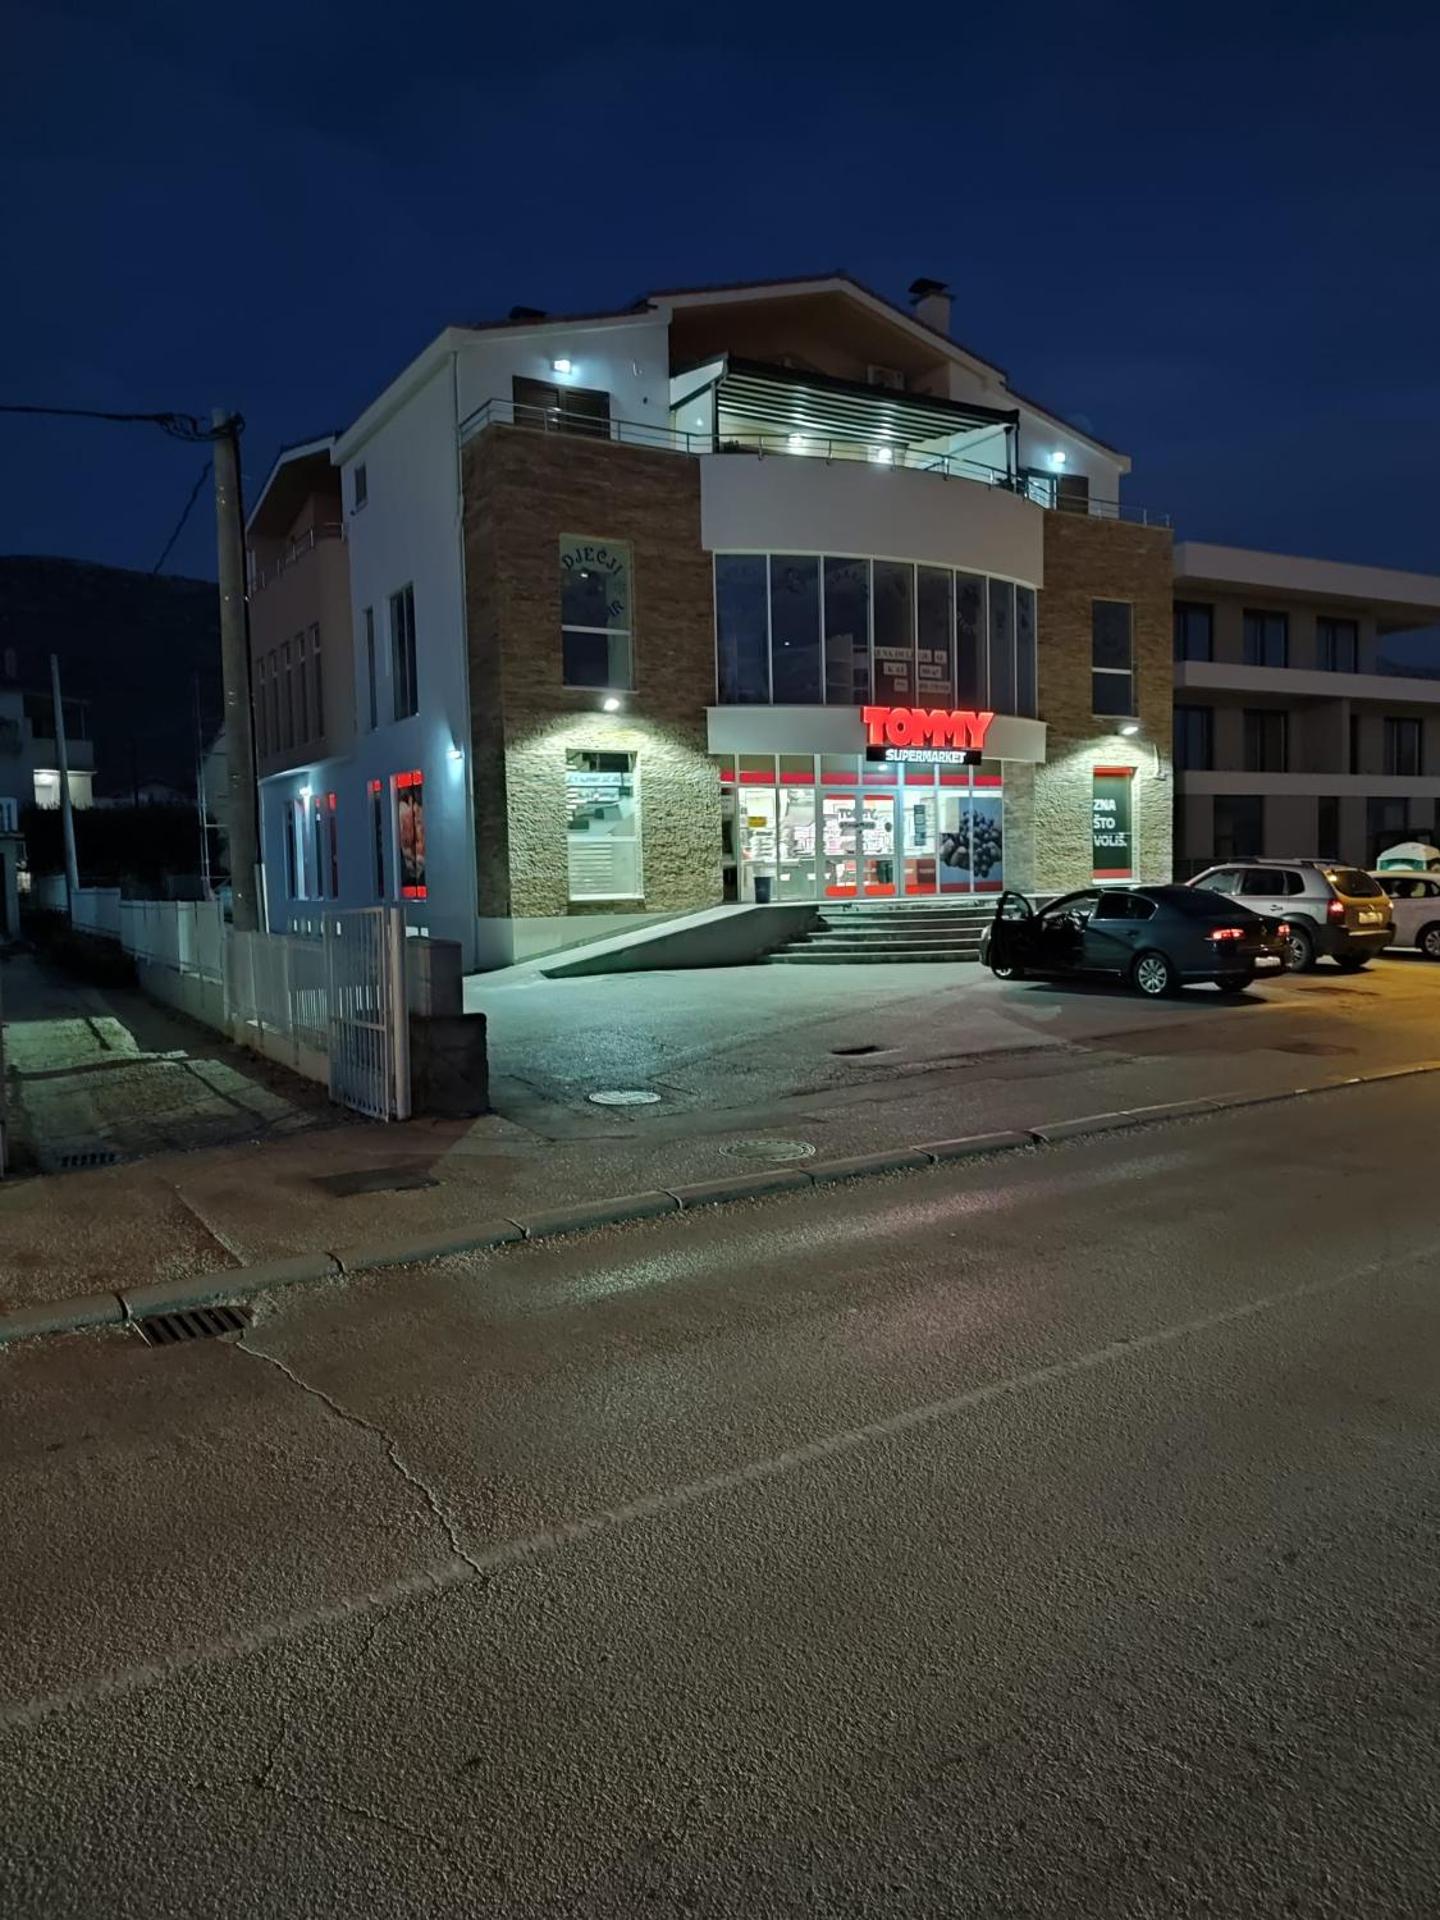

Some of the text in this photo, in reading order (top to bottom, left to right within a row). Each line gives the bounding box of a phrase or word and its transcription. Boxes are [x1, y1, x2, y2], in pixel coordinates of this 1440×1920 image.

[863, 706, 994, 748] TOMMY
[885, 748, 967, 763] SUPERMARKET
[1093, 798, 1117, 811] ZNA
[1093, 813, 1116, 829] ŠTO
